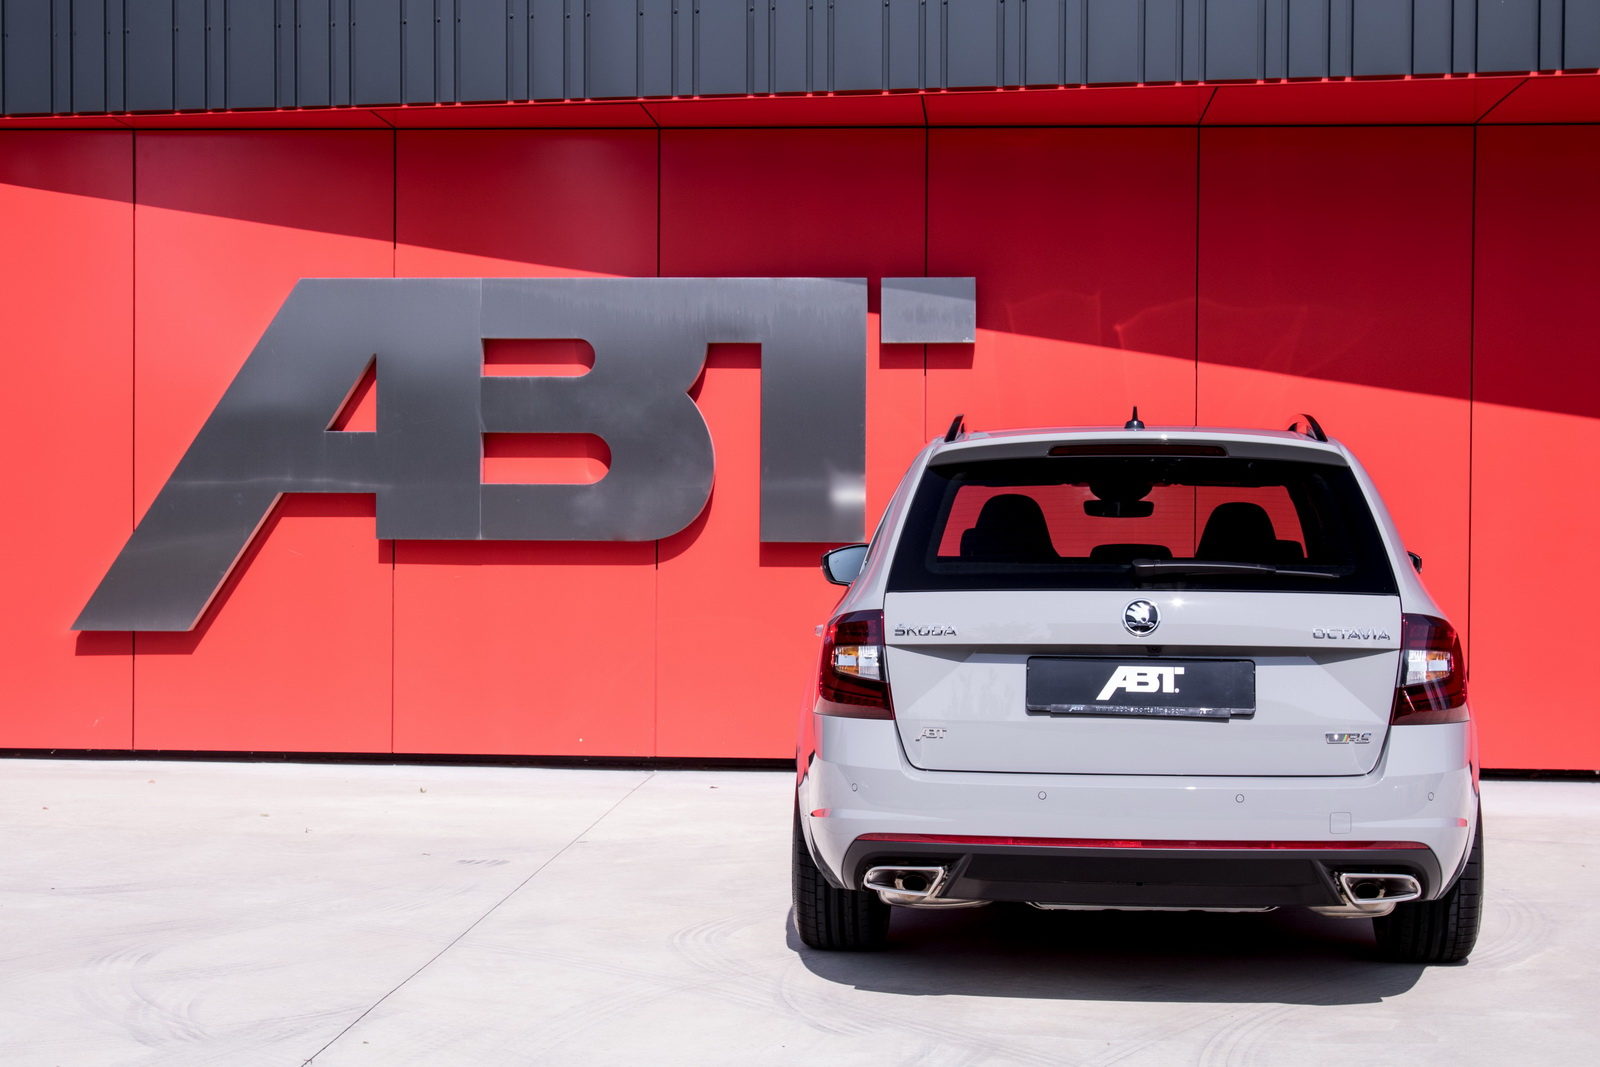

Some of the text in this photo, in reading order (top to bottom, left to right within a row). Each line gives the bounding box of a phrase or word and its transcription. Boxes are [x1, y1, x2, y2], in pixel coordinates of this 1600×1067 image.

[72, 277, 976, 631] ABT
[1312, 627, 1391, 641] OCTAVIA
[914, 726, 948, 742] ABT
